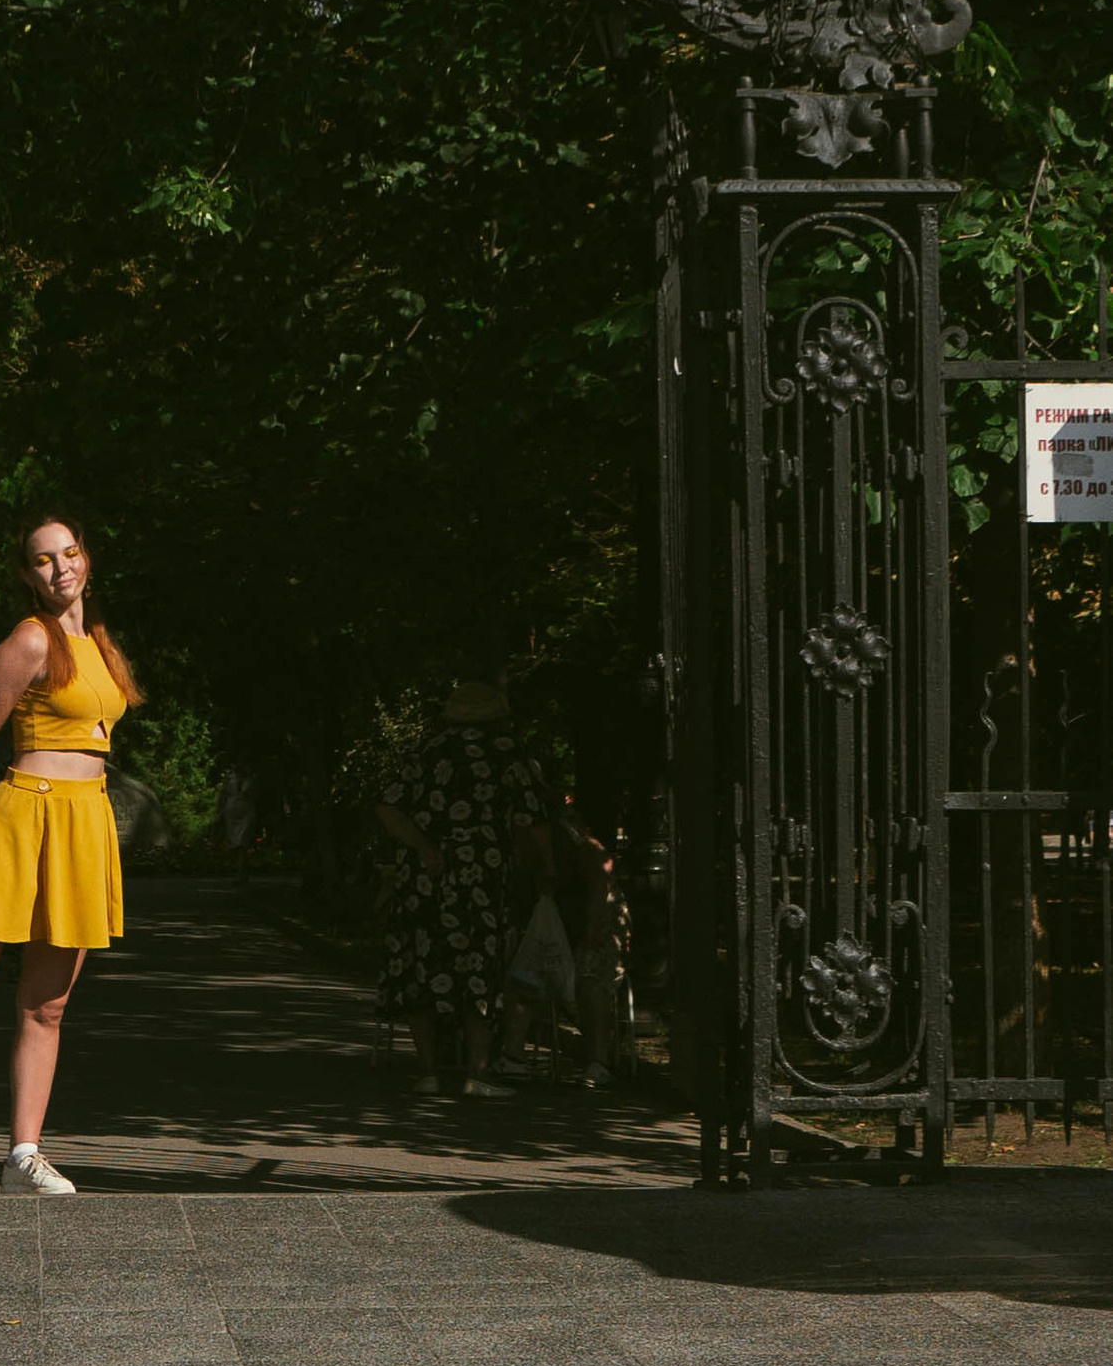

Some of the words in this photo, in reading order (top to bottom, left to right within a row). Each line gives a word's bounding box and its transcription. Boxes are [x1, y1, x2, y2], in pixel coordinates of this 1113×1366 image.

[1035, 408, 1089, 423] РЕЖИМ
[1038, 439, 1085, 453] парка
[1040, 483, 1048, 495] с
[1053, 479, 1083, 495] 7.30
[1086, 482, 1108, 498] до
